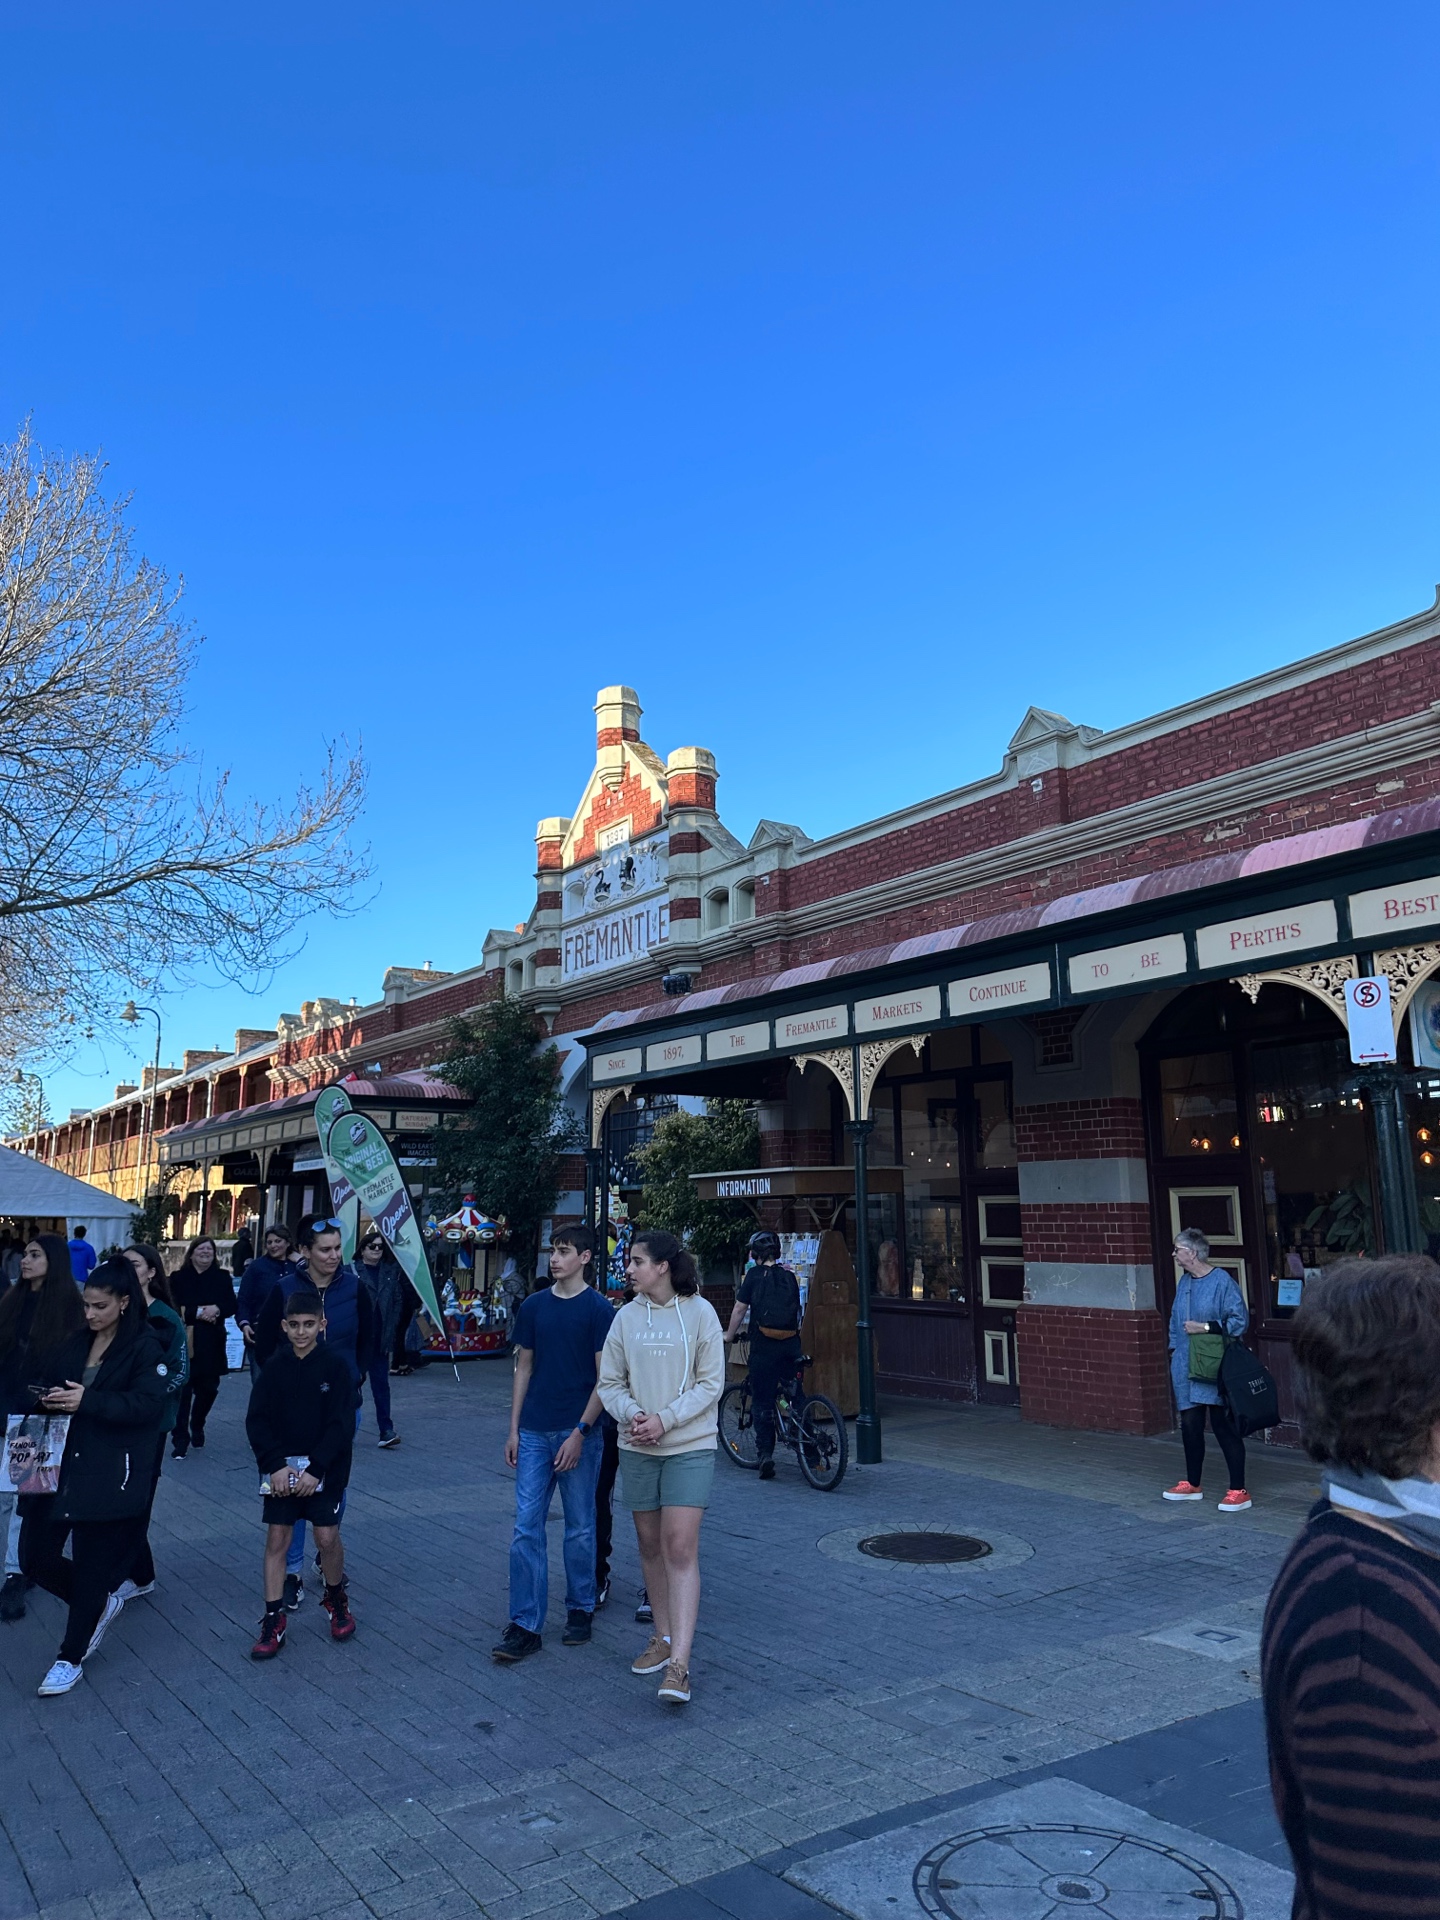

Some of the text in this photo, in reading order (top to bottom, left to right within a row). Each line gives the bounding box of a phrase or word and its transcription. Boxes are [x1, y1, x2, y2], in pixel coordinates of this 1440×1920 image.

[606, 828, 624, 846] 1897
[565, 903, 669, 973] FREMANTLE
[608, 894, 1440, 1070] SINCE 1897, THE FREMANTLE MARKETS CONTINUE TO BE PERTH'S BEST
[344, 1142, 380, 1168] ORIGINAL
[366, 1149, 388, 1172] BEST
[233, 1167, 288, 1176] OAKBRRY
[363, 1173, 395, 1195] FREMANTLE
[368, 1183, 394, 1201] MARKETS
[716, 1178, 770, 1196] INFORMATION
[382, 1191, 408, 1238] Open!
[10, 1452, 54, 1463] POP ART
